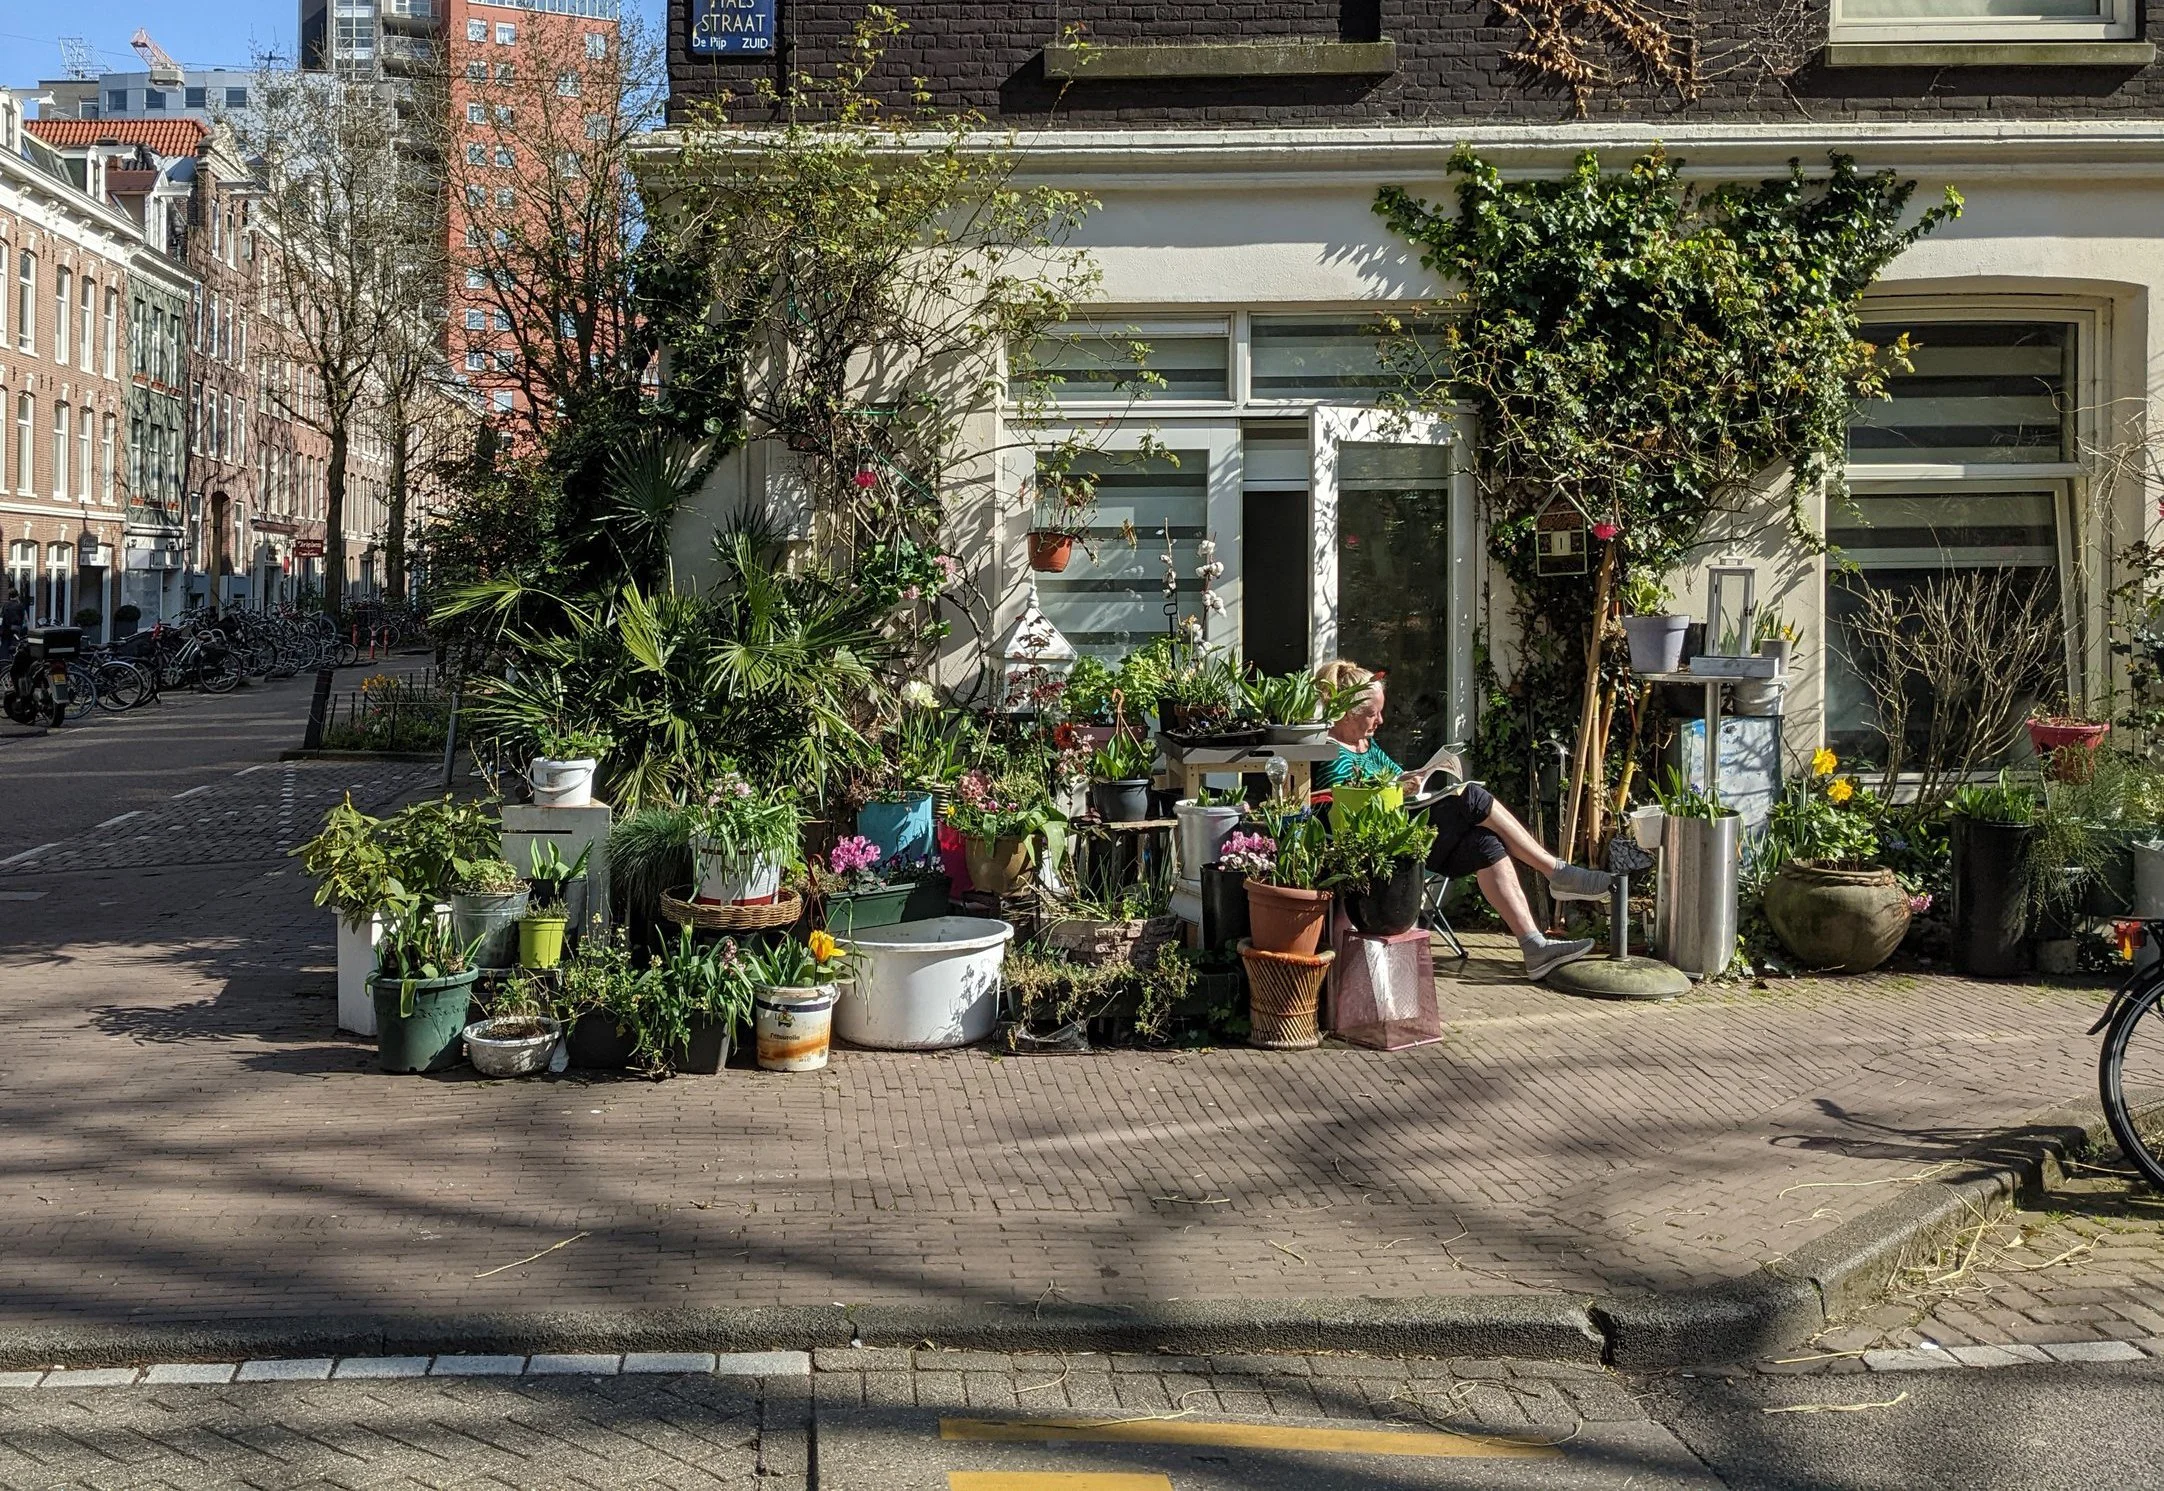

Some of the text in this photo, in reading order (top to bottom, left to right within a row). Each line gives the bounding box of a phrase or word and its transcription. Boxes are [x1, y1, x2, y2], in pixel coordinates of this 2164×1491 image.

[701, 14, 766, 32] STRAAT
[692, 36, 769, 50] De Pijp ZUID
